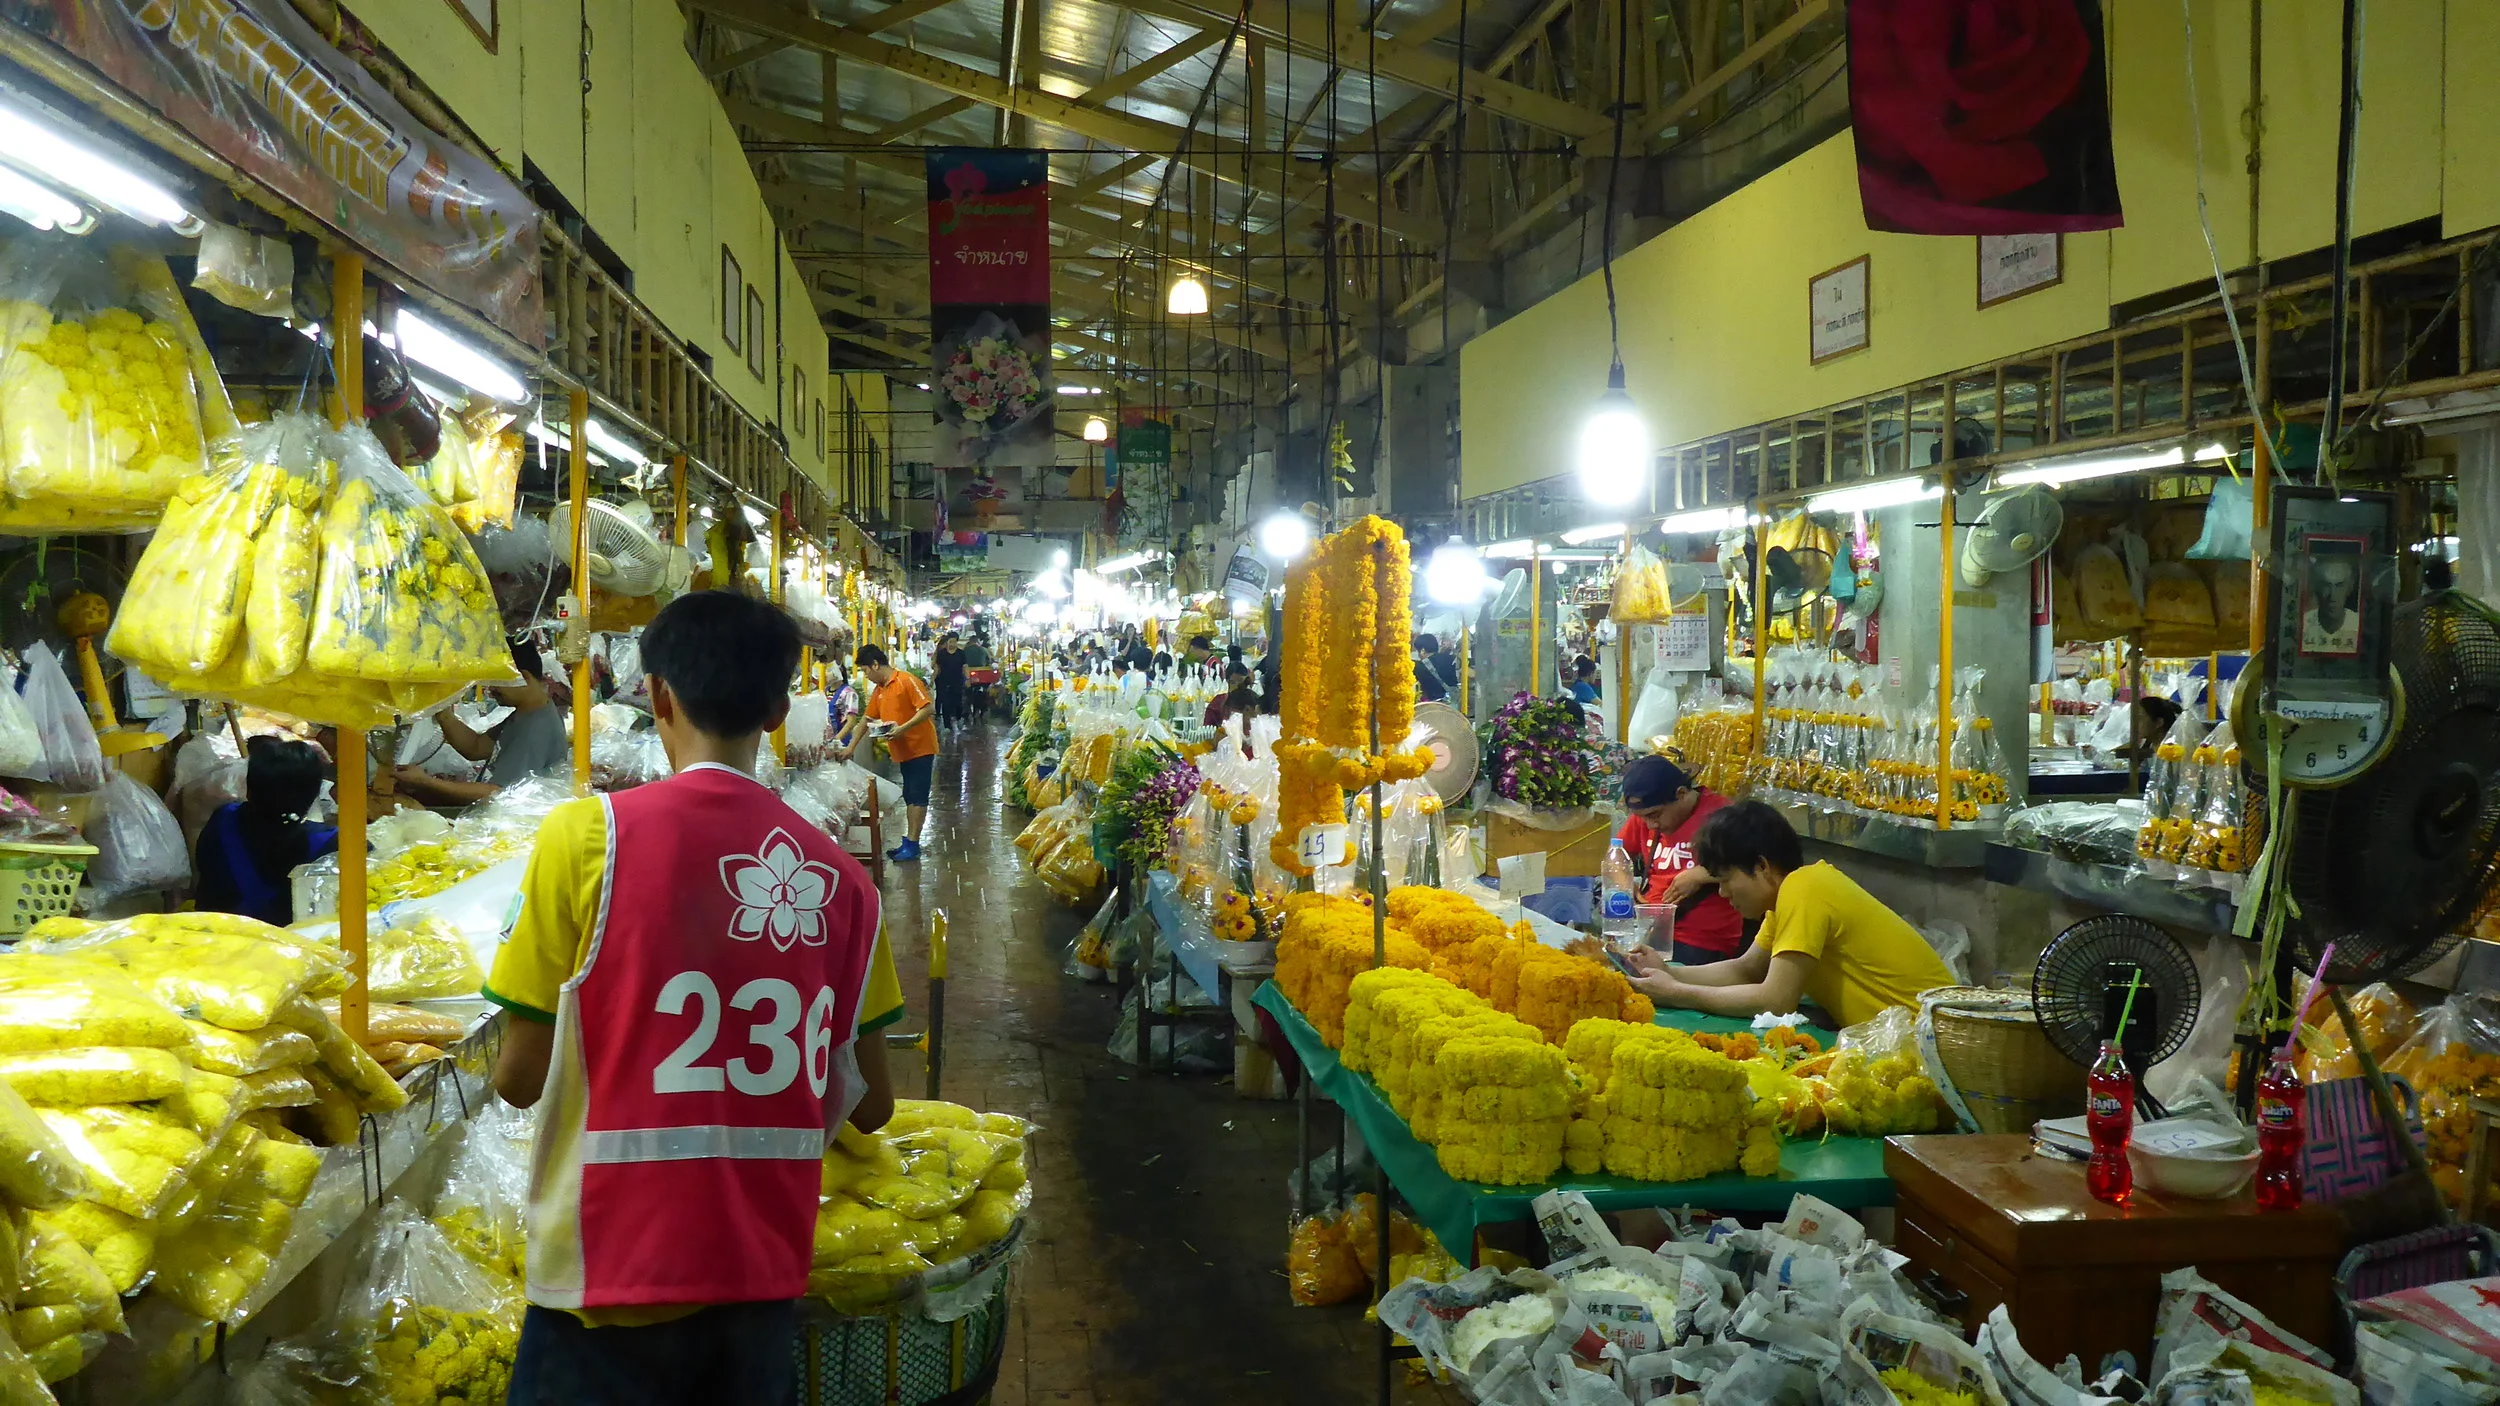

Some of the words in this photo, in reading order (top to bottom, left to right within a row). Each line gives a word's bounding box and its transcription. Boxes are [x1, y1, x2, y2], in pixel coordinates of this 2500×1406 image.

[954, 239, 1029, 266] จำหน่าย
[2358, 726, 2368, 743] 4
[2306, 752, 2317, 768] 6
[2337, 744, 2347, 760] 5
[1304, 832, 1325, 857] 15
[653, 970, 836, 1099] 236
[2092, 1097, 2122, 1110] FANTA
[1587, 1302, 1613, 1316] 体育
